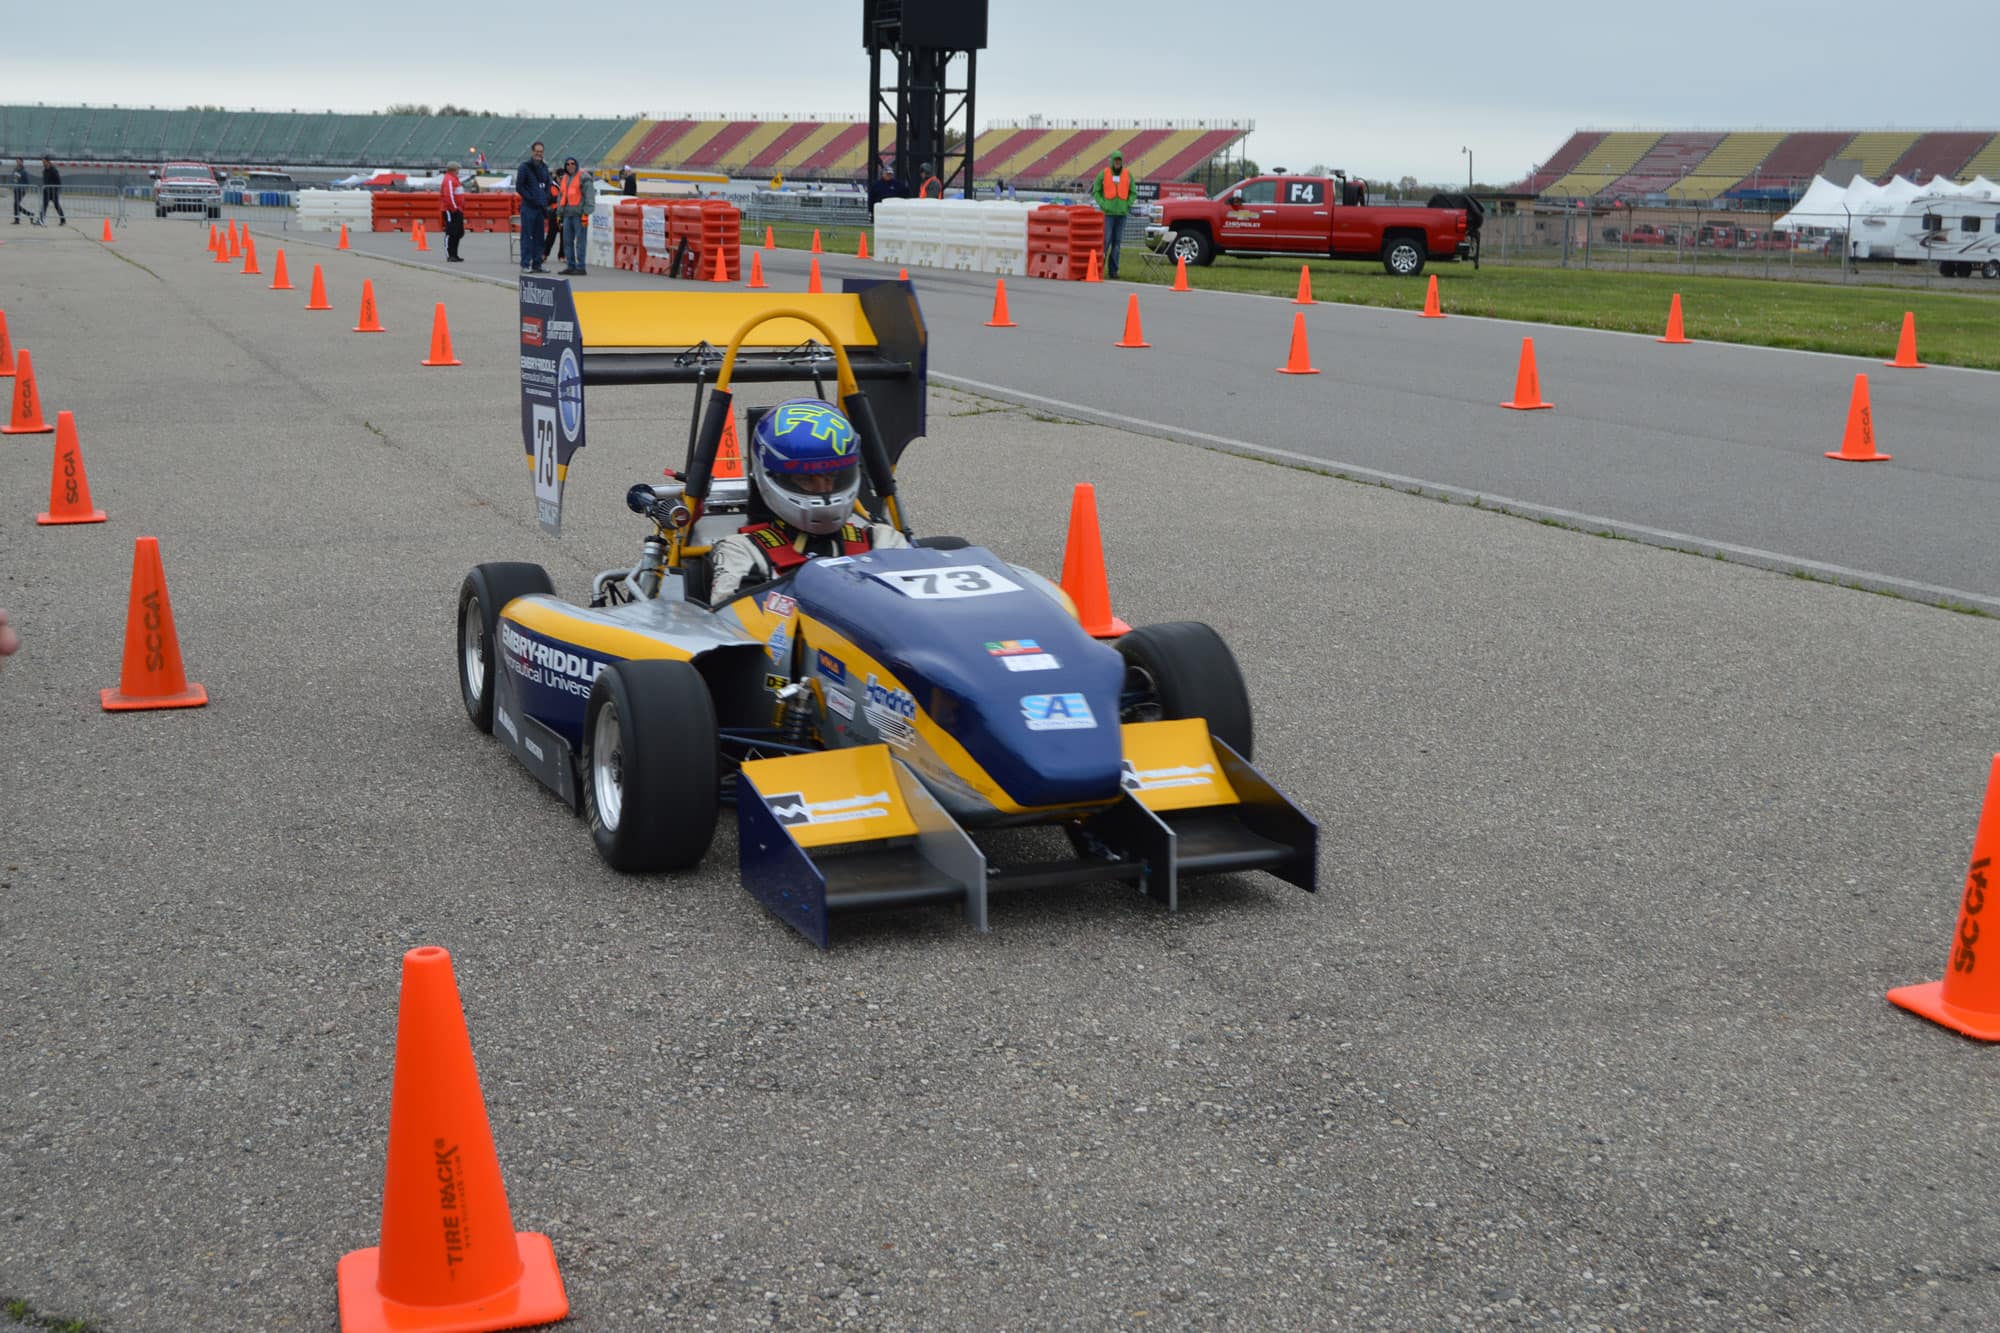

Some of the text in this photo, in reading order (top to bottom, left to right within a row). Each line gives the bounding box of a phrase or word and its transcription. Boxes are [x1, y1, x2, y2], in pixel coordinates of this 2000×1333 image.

[1291, 184, 1314, 204] F4
[63, 450, 78, 505] SCCA
[537, 419, 553, 487] 73
[901, 570, 991, 594] 73
[142, 589, 164, 673] SCCA
[540, 670, 592, 699] Univers
[1022, 694, 1090, 719] SAE
[1954, 857, 1991, 974] SCCA
[443, 1216, 463, 1266] TIRE
